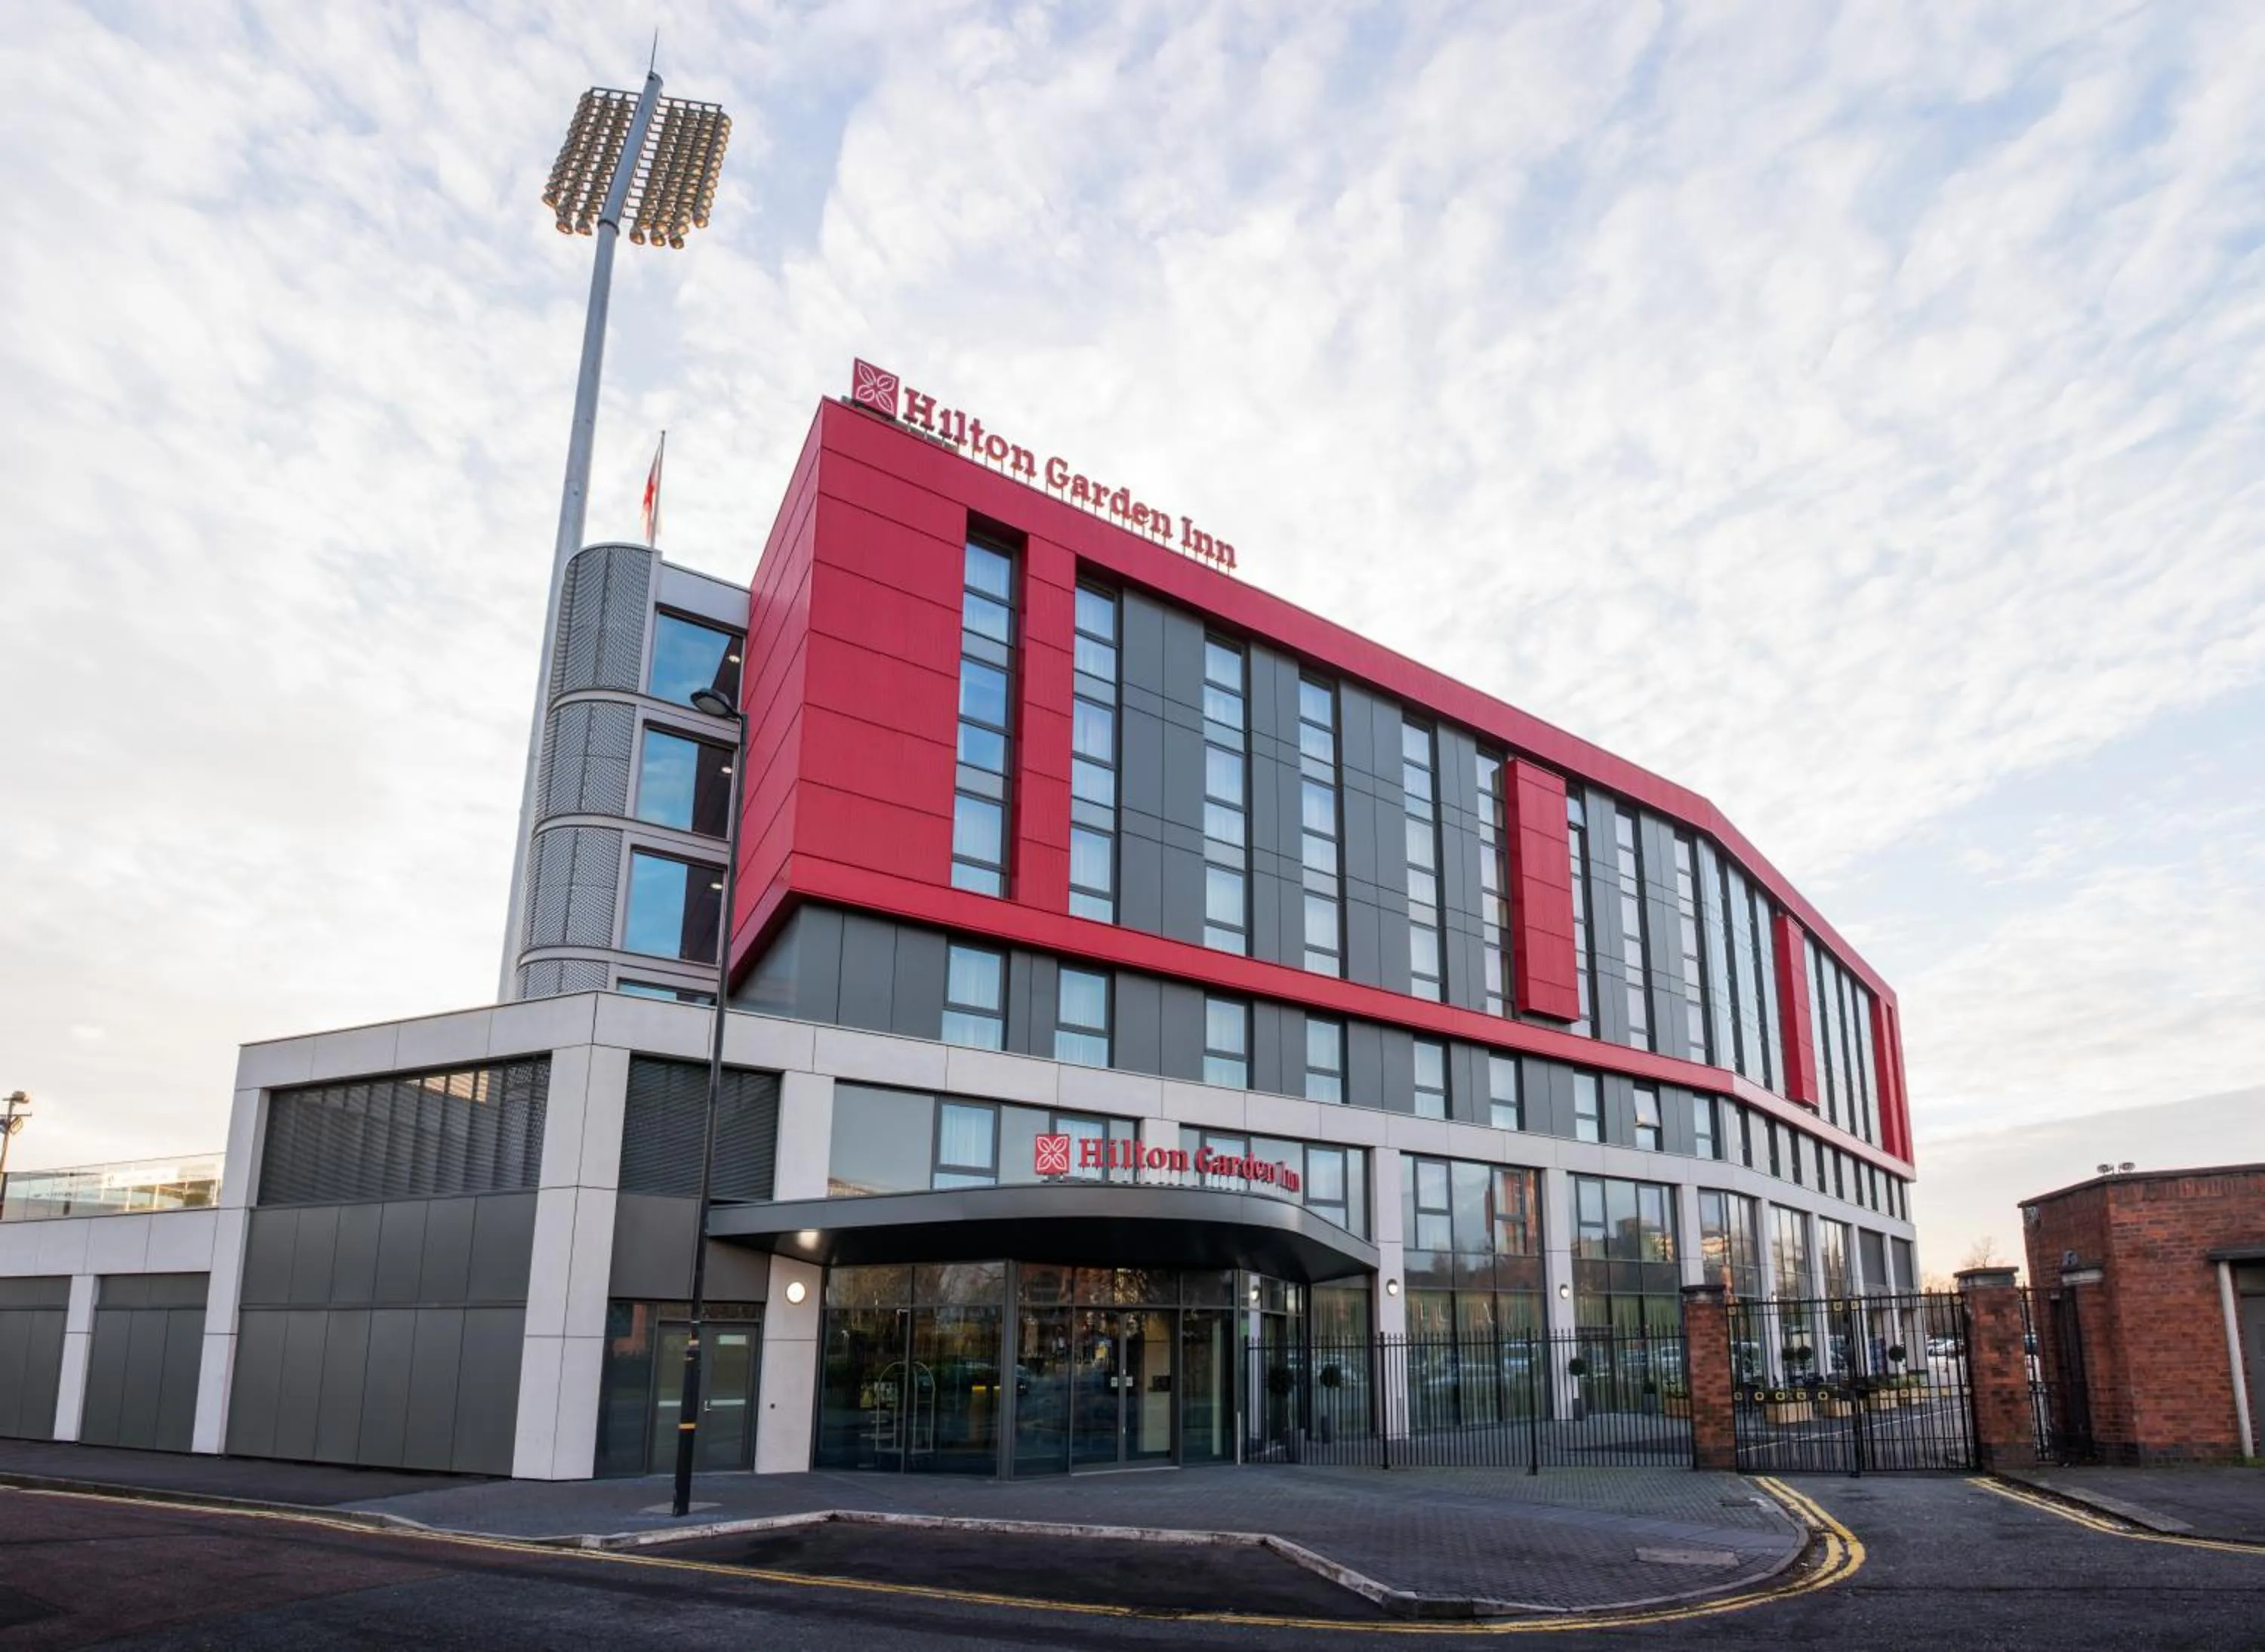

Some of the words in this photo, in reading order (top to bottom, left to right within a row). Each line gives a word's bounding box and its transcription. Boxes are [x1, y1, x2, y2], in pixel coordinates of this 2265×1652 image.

[904, 387, 1037, 477] Hilton
[1046, 457, 1173, 538] Garden
[1181, 516, 1237, 568] Inn
[1078, 1138, 1190, 1171] Hilton
[1195, 1146, 1275, 1183] Garden
[1277, 1160, 1299, 1191] Inn
